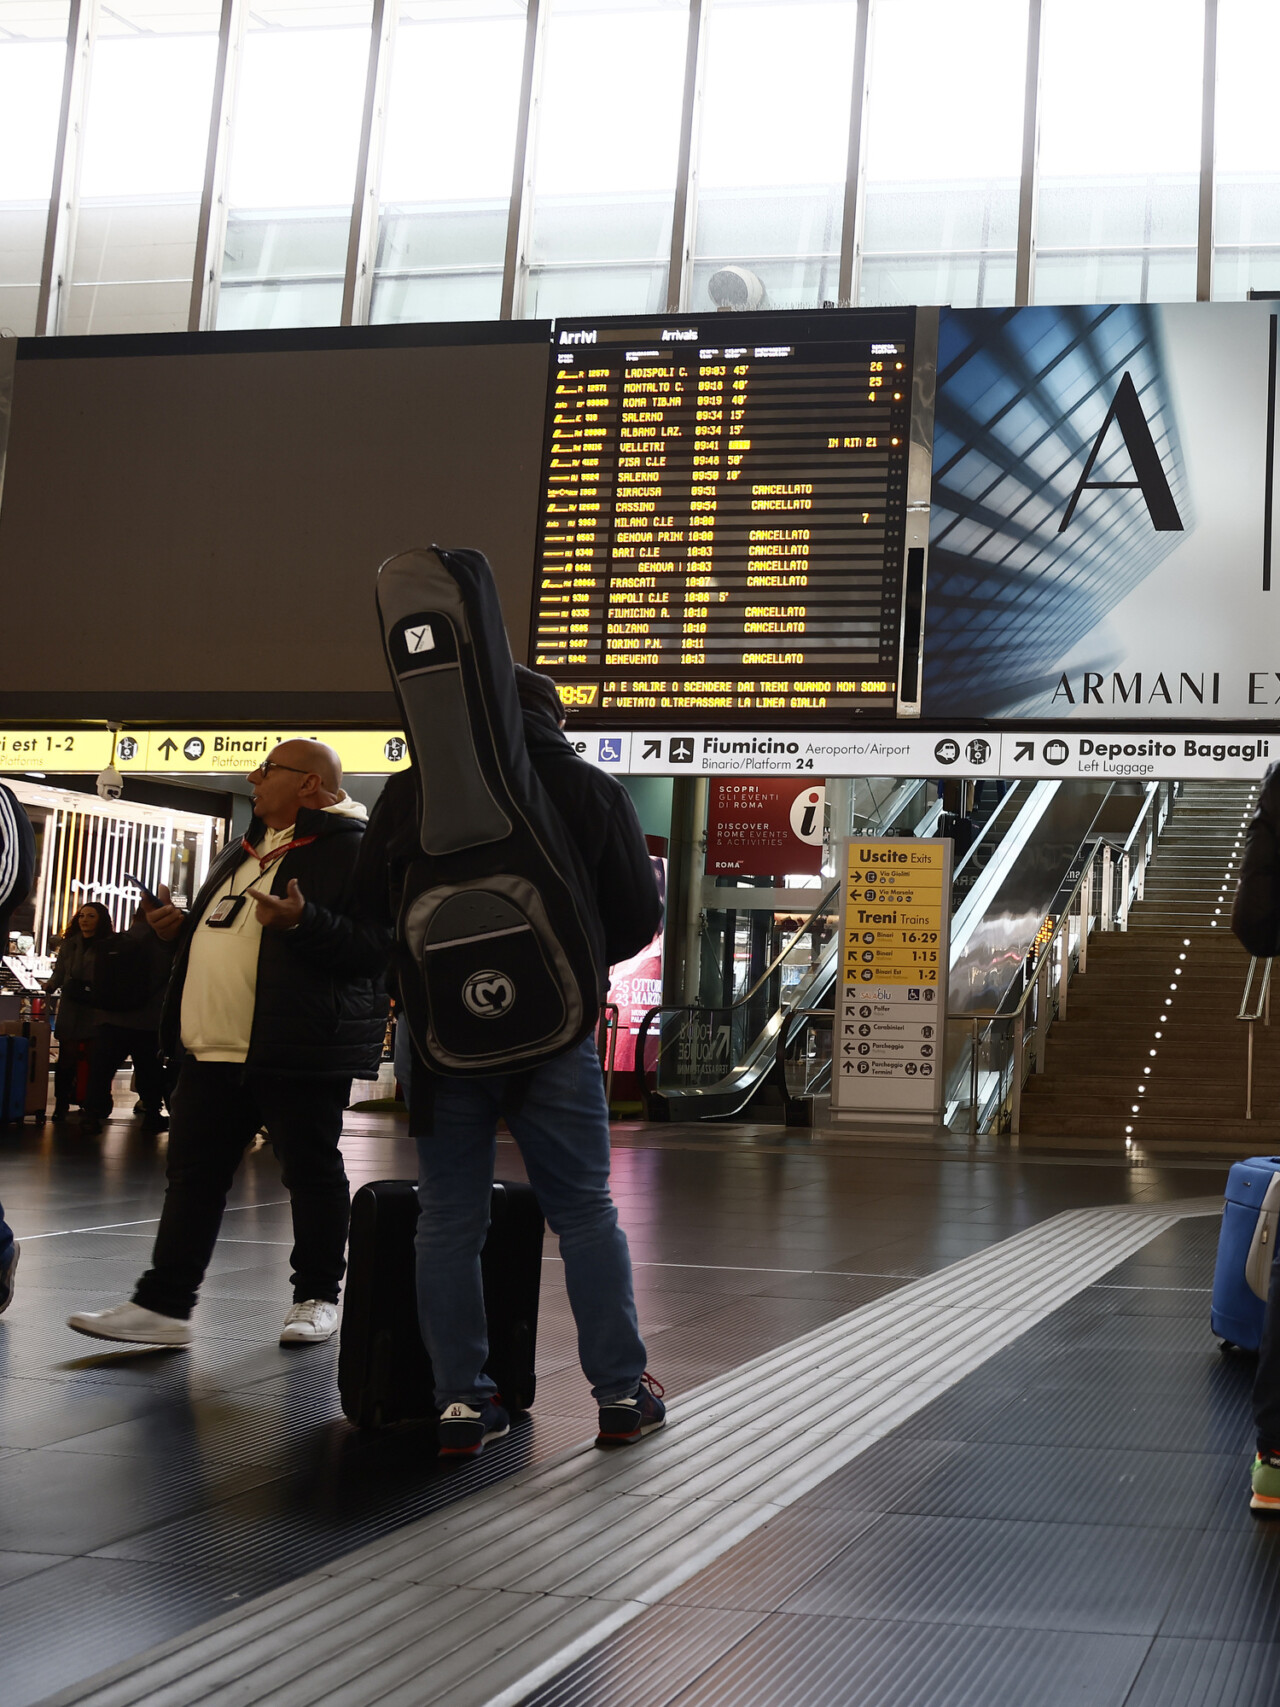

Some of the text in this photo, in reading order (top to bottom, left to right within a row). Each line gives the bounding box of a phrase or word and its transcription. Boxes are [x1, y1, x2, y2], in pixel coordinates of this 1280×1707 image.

[559, 329, 698, 344] Arrivi Arrivals
[625, 367, 688, 378] LADISPOLI C.
[624, 382, 685, 393] MONTALTO C.
[622, 412, 663, 422] SALERNO
[621, 427, 682, 437] ALBANO LAZ.
[620, 442, 665, 452] VELLETRI
[618, 456, 666, 467] PISA C.LE
[618, 472, 659, 482] SALERNO
[617, 484, 812, 497] SIRACUSA CANCELLATO
[615, 500, 812, 511] CASSINO CANCELLATO
[614, 517, 673, 528] MILANO C.LE
[617, 530, 810, 543] GENOVA CANCELLATO
[612, 545, 809, 558] BARI C.LE CANCELLATO
[638, 560, 808, 572] GENOVA CANCELLATO
[610, 575, 807, 588] FRASCATI CANCELLATO
[609, 592, 669, 603] NAPOLI C.LE
[608, 606, 806, 618] FIUMICINO A. CANCELLATO
[607, 622, 805, 634] BOLZANO CANCELLATO
[607, 639, 663, 649] TORINO P.N.
[605, 654, 803, 664] BENEVENTO CANCELLATO
[1052, 673, 1221, 704] ARMANI
[12, 738, 37, 751] est
[47, 736, 74, 751] 1-2
[214, 736, 267, 751] Binari
[703, 737, 911, 757] Fiumicino Aeroporto/Airport
[1078, 739, 1269, 761] Deposito Bagagli
[212, 756, 256, 767] Platforms
[702, 758, 813, 770] Binario/Platform 24
[1078, 761, 1154, 775] Left Luggage
[859, 849, 932, 864] Uscite Exits
[857, 910, 929, 925] Treni Trains
